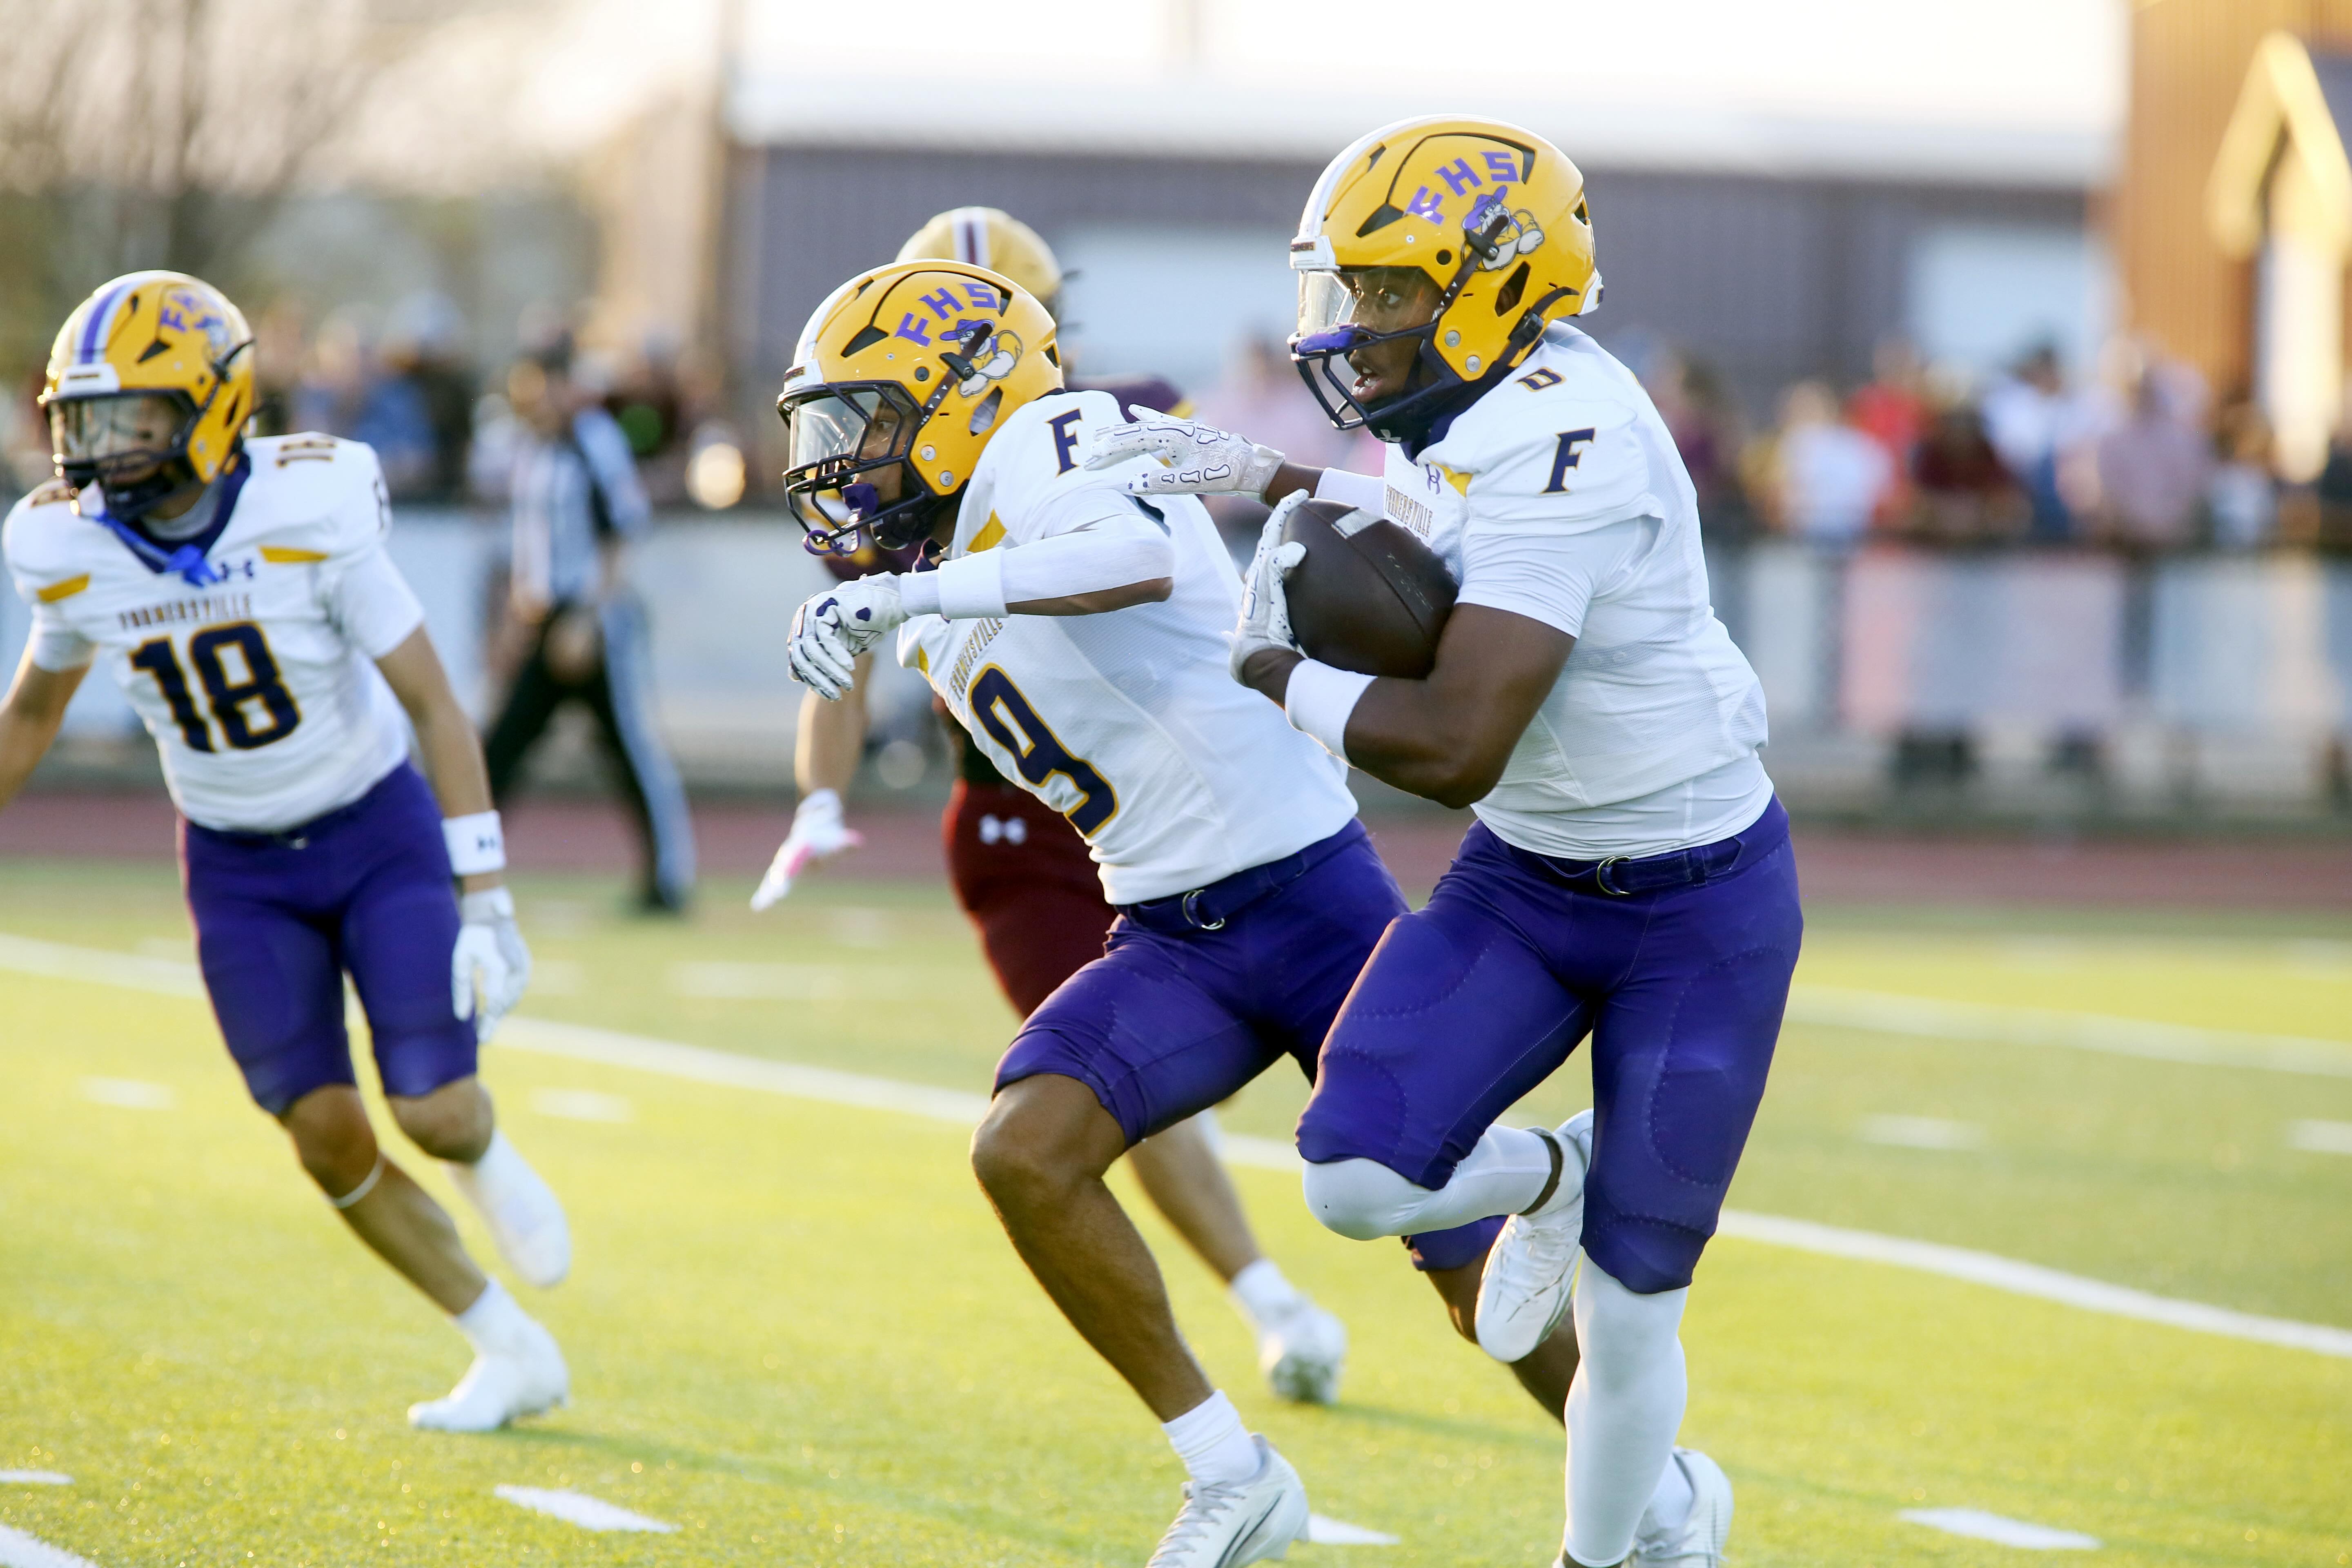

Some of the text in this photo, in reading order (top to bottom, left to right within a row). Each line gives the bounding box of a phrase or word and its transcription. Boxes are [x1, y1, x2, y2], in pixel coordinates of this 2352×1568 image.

[1404, 151, 1520, 226] FHS
[893, 283, 1000, 348] FHS
[1044, 407, 1085, 479] F
[1539, 426, 1597, 495] F
[127, 619, 303, 755] 18
[967, 662, 1119, 838] 9
